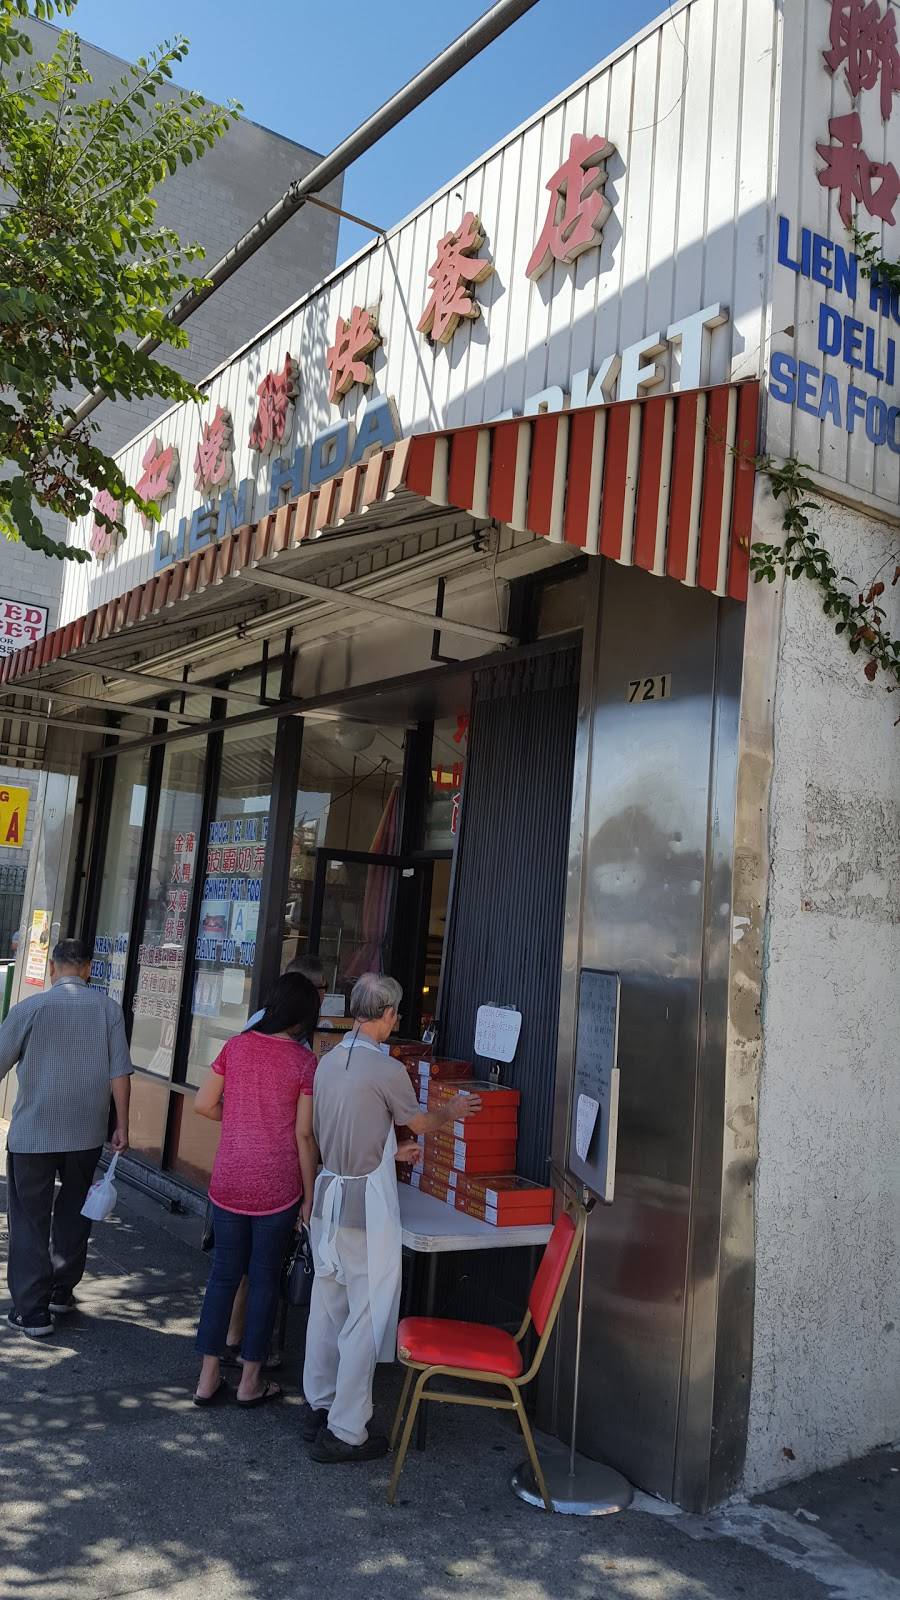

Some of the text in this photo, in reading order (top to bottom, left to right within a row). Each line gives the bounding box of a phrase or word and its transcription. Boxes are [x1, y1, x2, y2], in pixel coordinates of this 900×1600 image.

[778, 216, 858, 301] LIEN
[818, 302, 896, 386] DELI
[154, 480, 254, 571] LIEN
[268, 393, 398, 510] HOA
[0, 602, 42, 625] ED
[629, 675, 666, 702] 721
[234, 908, 245, 931] A
